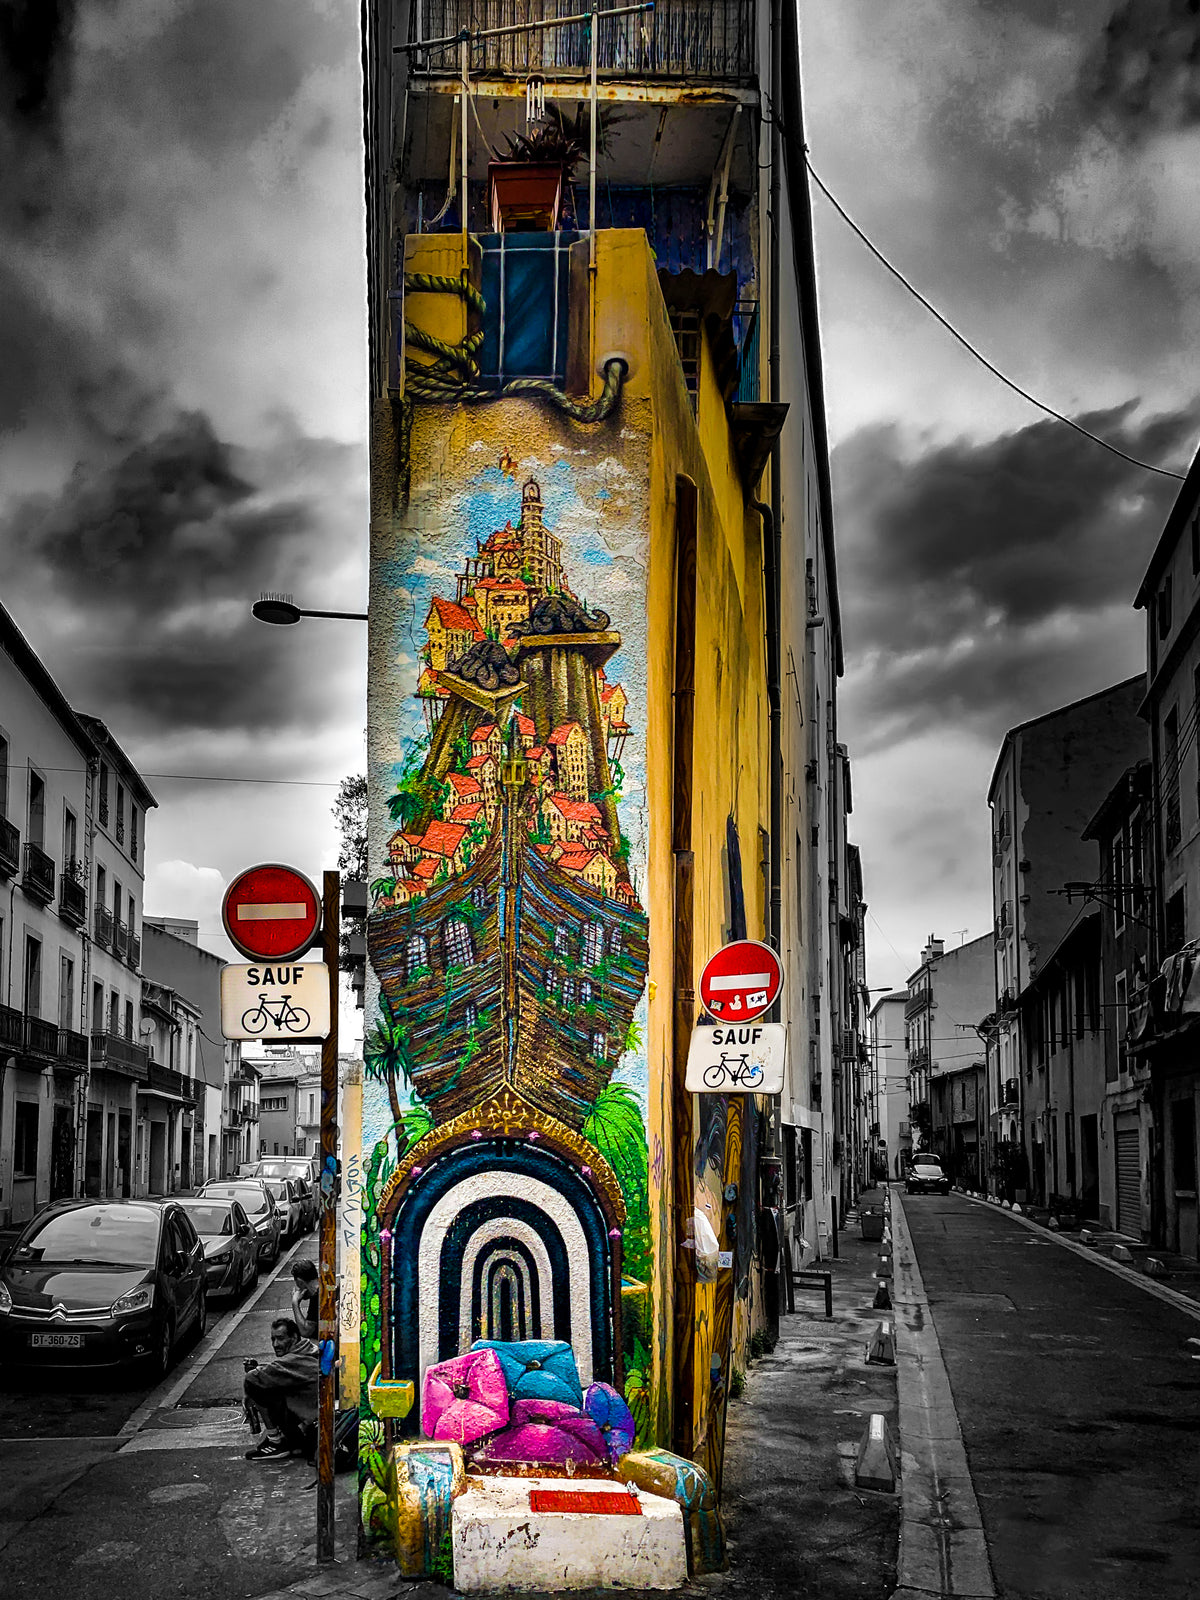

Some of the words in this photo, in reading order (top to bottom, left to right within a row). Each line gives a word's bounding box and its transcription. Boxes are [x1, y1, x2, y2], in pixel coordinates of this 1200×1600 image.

[247, 967, 304, 986] SAUF
[712, 1028, 763, 1046] SAUF
[33, 1335, 79, 1346] BT-360-ZS
